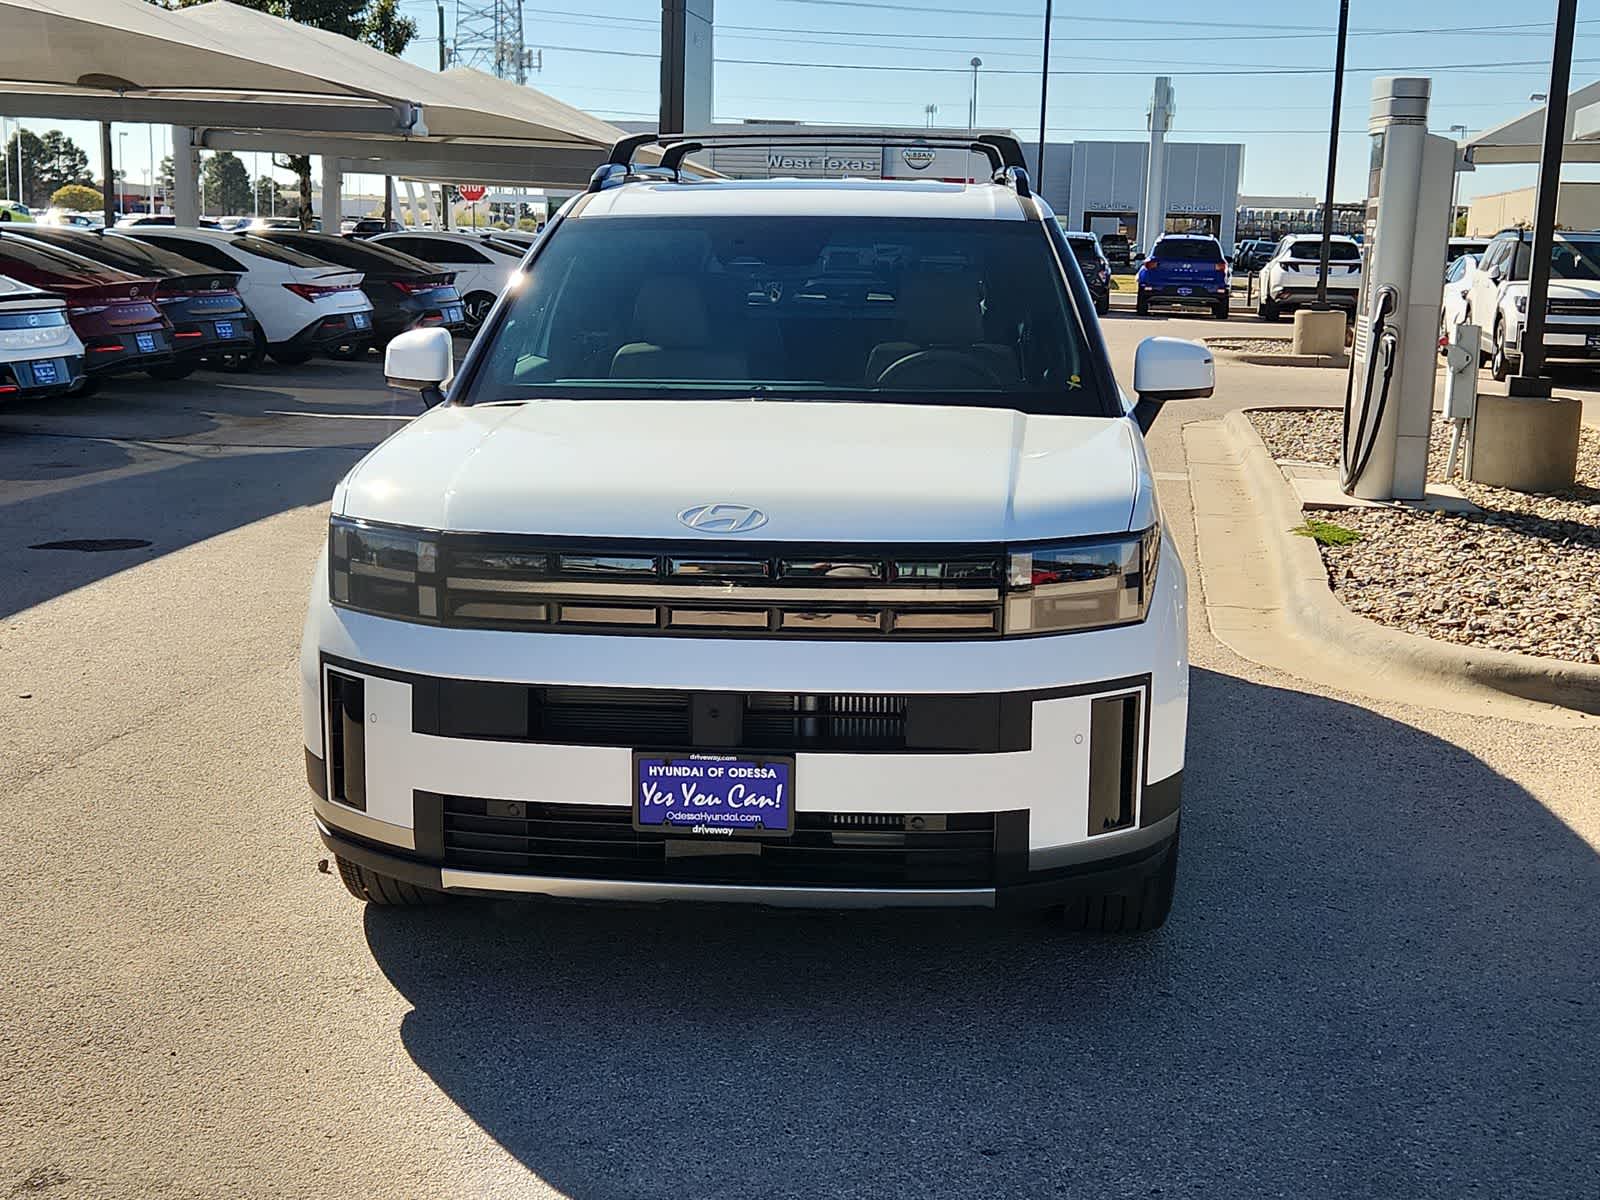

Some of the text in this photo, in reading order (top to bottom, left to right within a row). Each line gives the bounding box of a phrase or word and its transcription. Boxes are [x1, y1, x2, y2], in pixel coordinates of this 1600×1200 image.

[767, 155, 875, 170] West Texas
[689, 754, 737, 762] driveway.com
[649, 766, 777, 778] HYUNDAI OF ODESSA
[641, 782, 783, 809] Yes You Can!
[666, 811, 761, 822] OdessaHyundai.com
[692, 824, 734, 836] driveway
